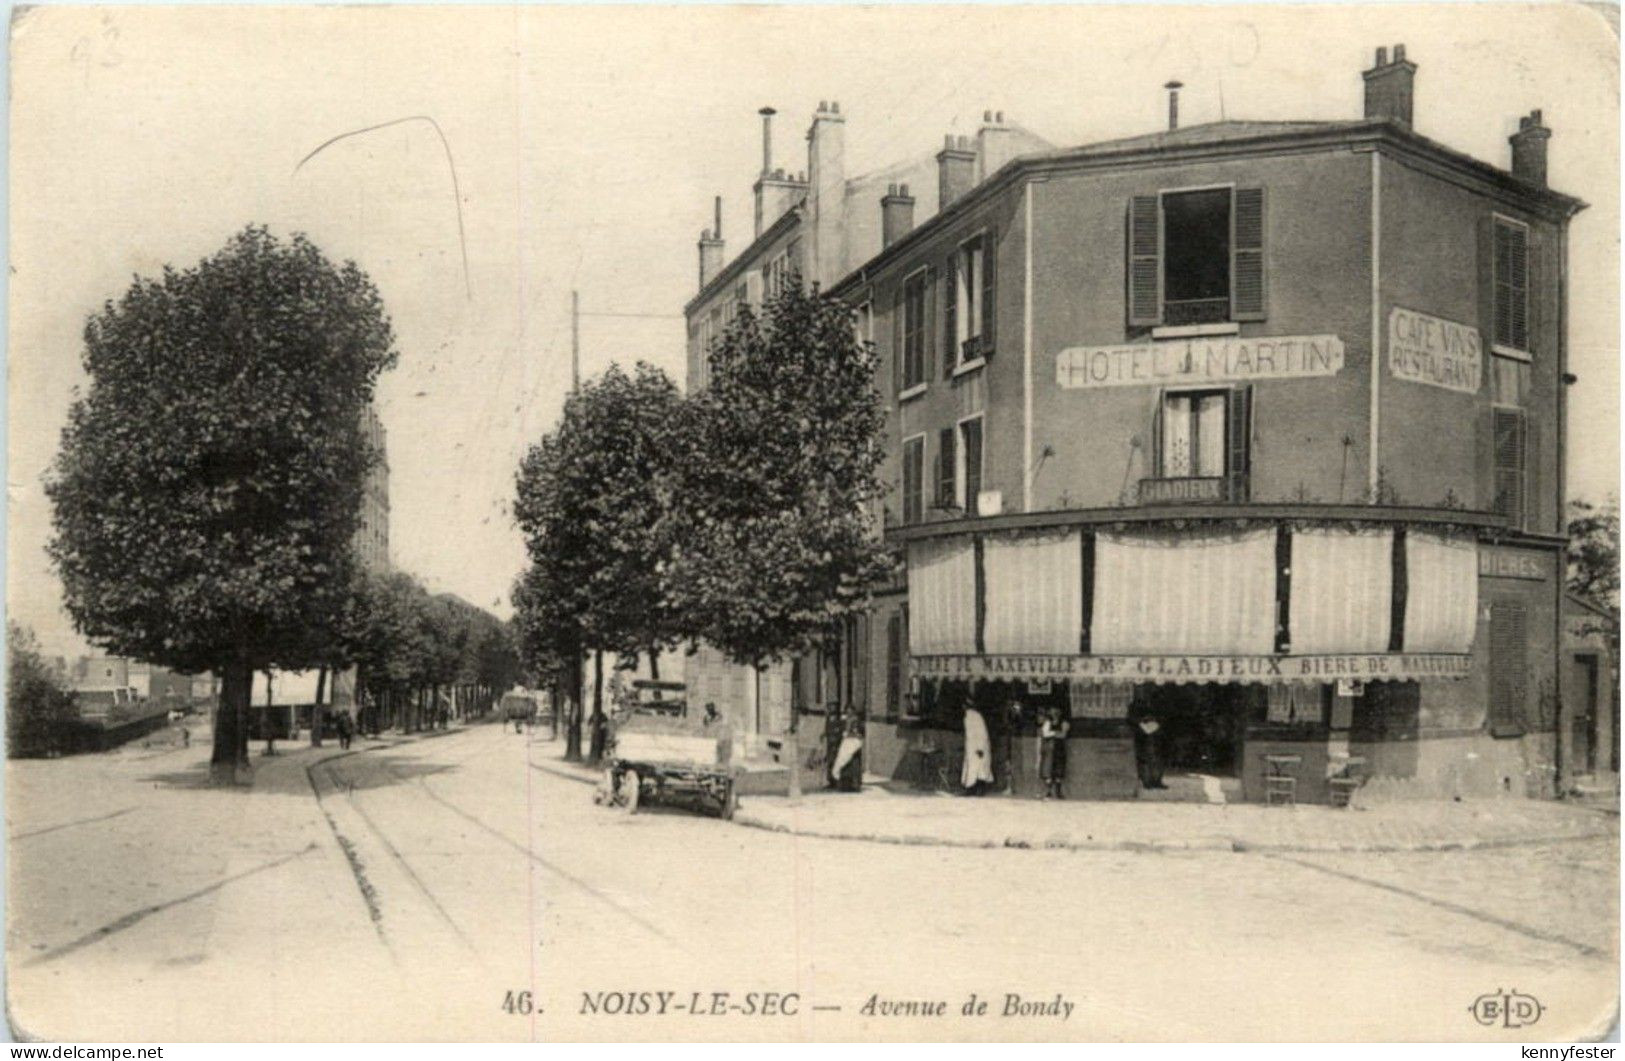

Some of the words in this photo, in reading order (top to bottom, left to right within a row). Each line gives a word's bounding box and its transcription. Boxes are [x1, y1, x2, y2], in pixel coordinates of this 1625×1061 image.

[1068, 350, 1173, 384] HOTEL
[1205, 340, 1331, 377] MARTIN
[1392, 346, 1478, 389] RESTAURANT
[1136, 656, 1282, 675] GLADIEUX
[1367, 656, 1390, 674] DE
